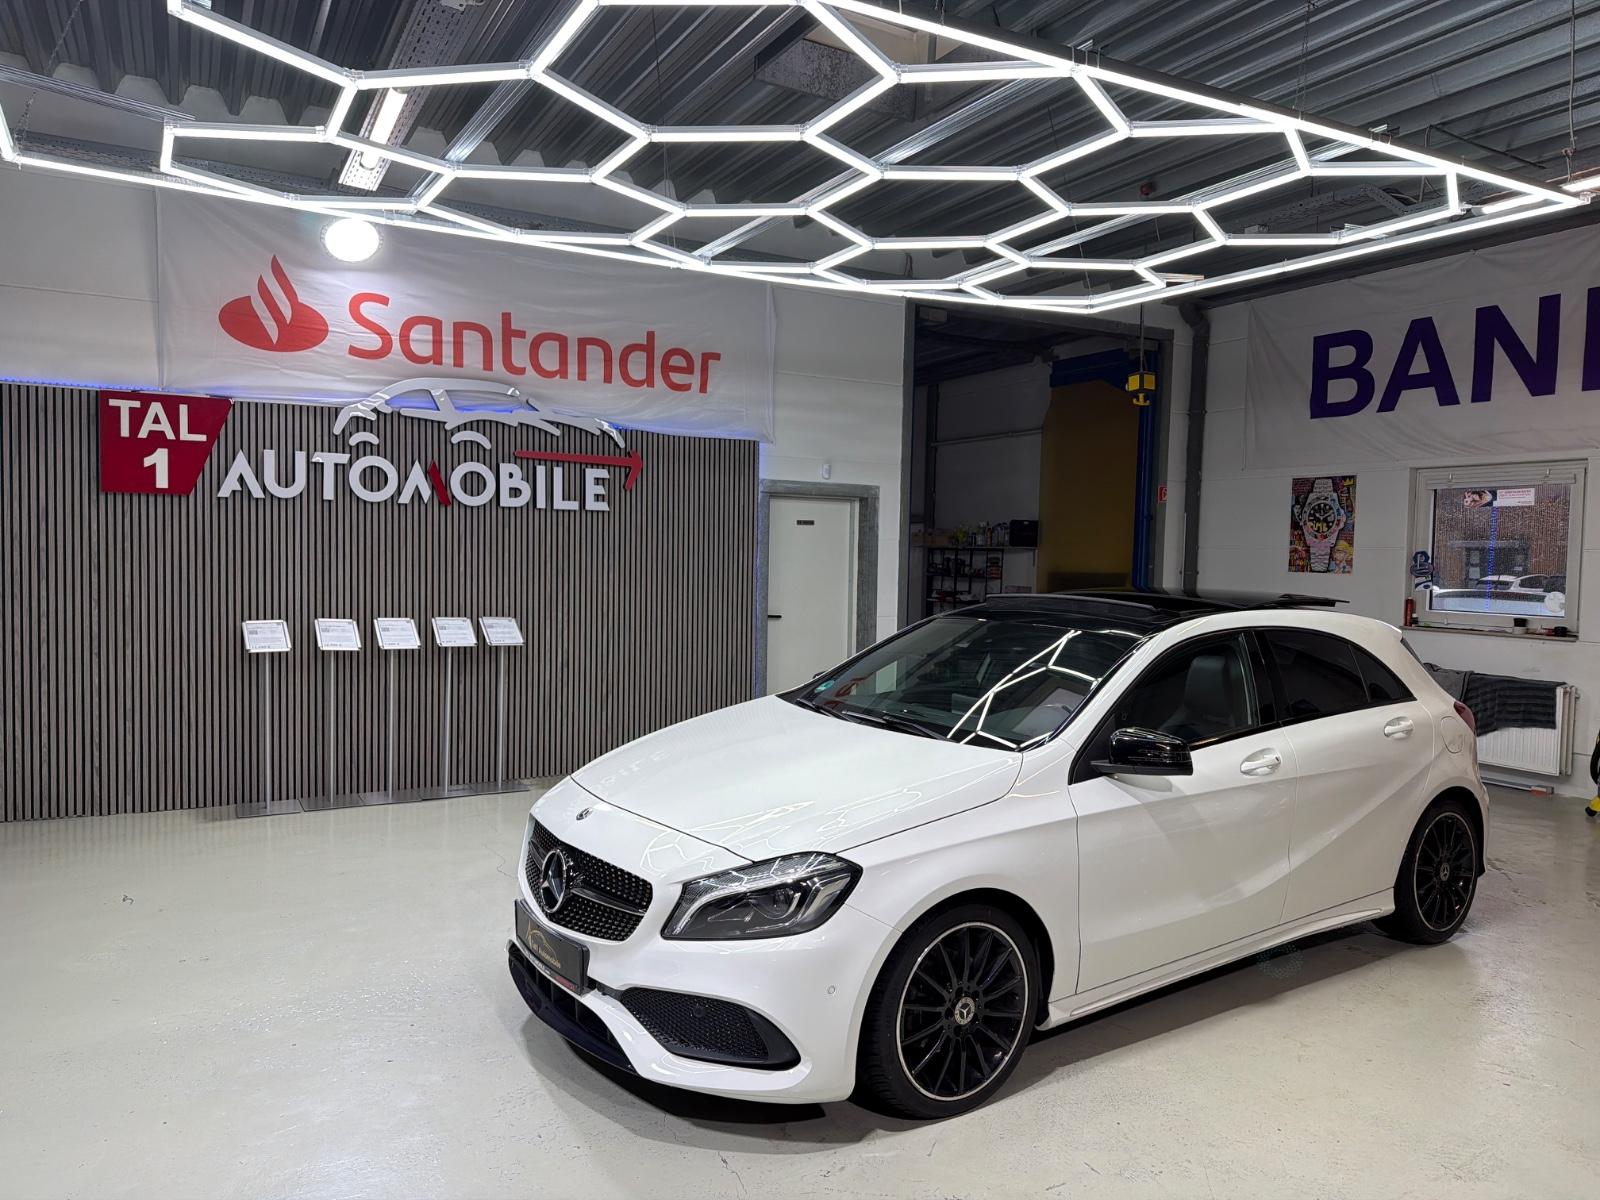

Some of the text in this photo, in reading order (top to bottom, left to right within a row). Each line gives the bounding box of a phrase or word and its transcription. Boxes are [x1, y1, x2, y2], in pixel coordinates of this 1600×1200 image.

[348, 292, 722, 394] Santander
[1310, 286, 1600, 419] BAN
[108, 398, 207, 442] TAL
[143, 448, 169, 489] 1
[217, 449, 610, 511] AUTOMOBILE
